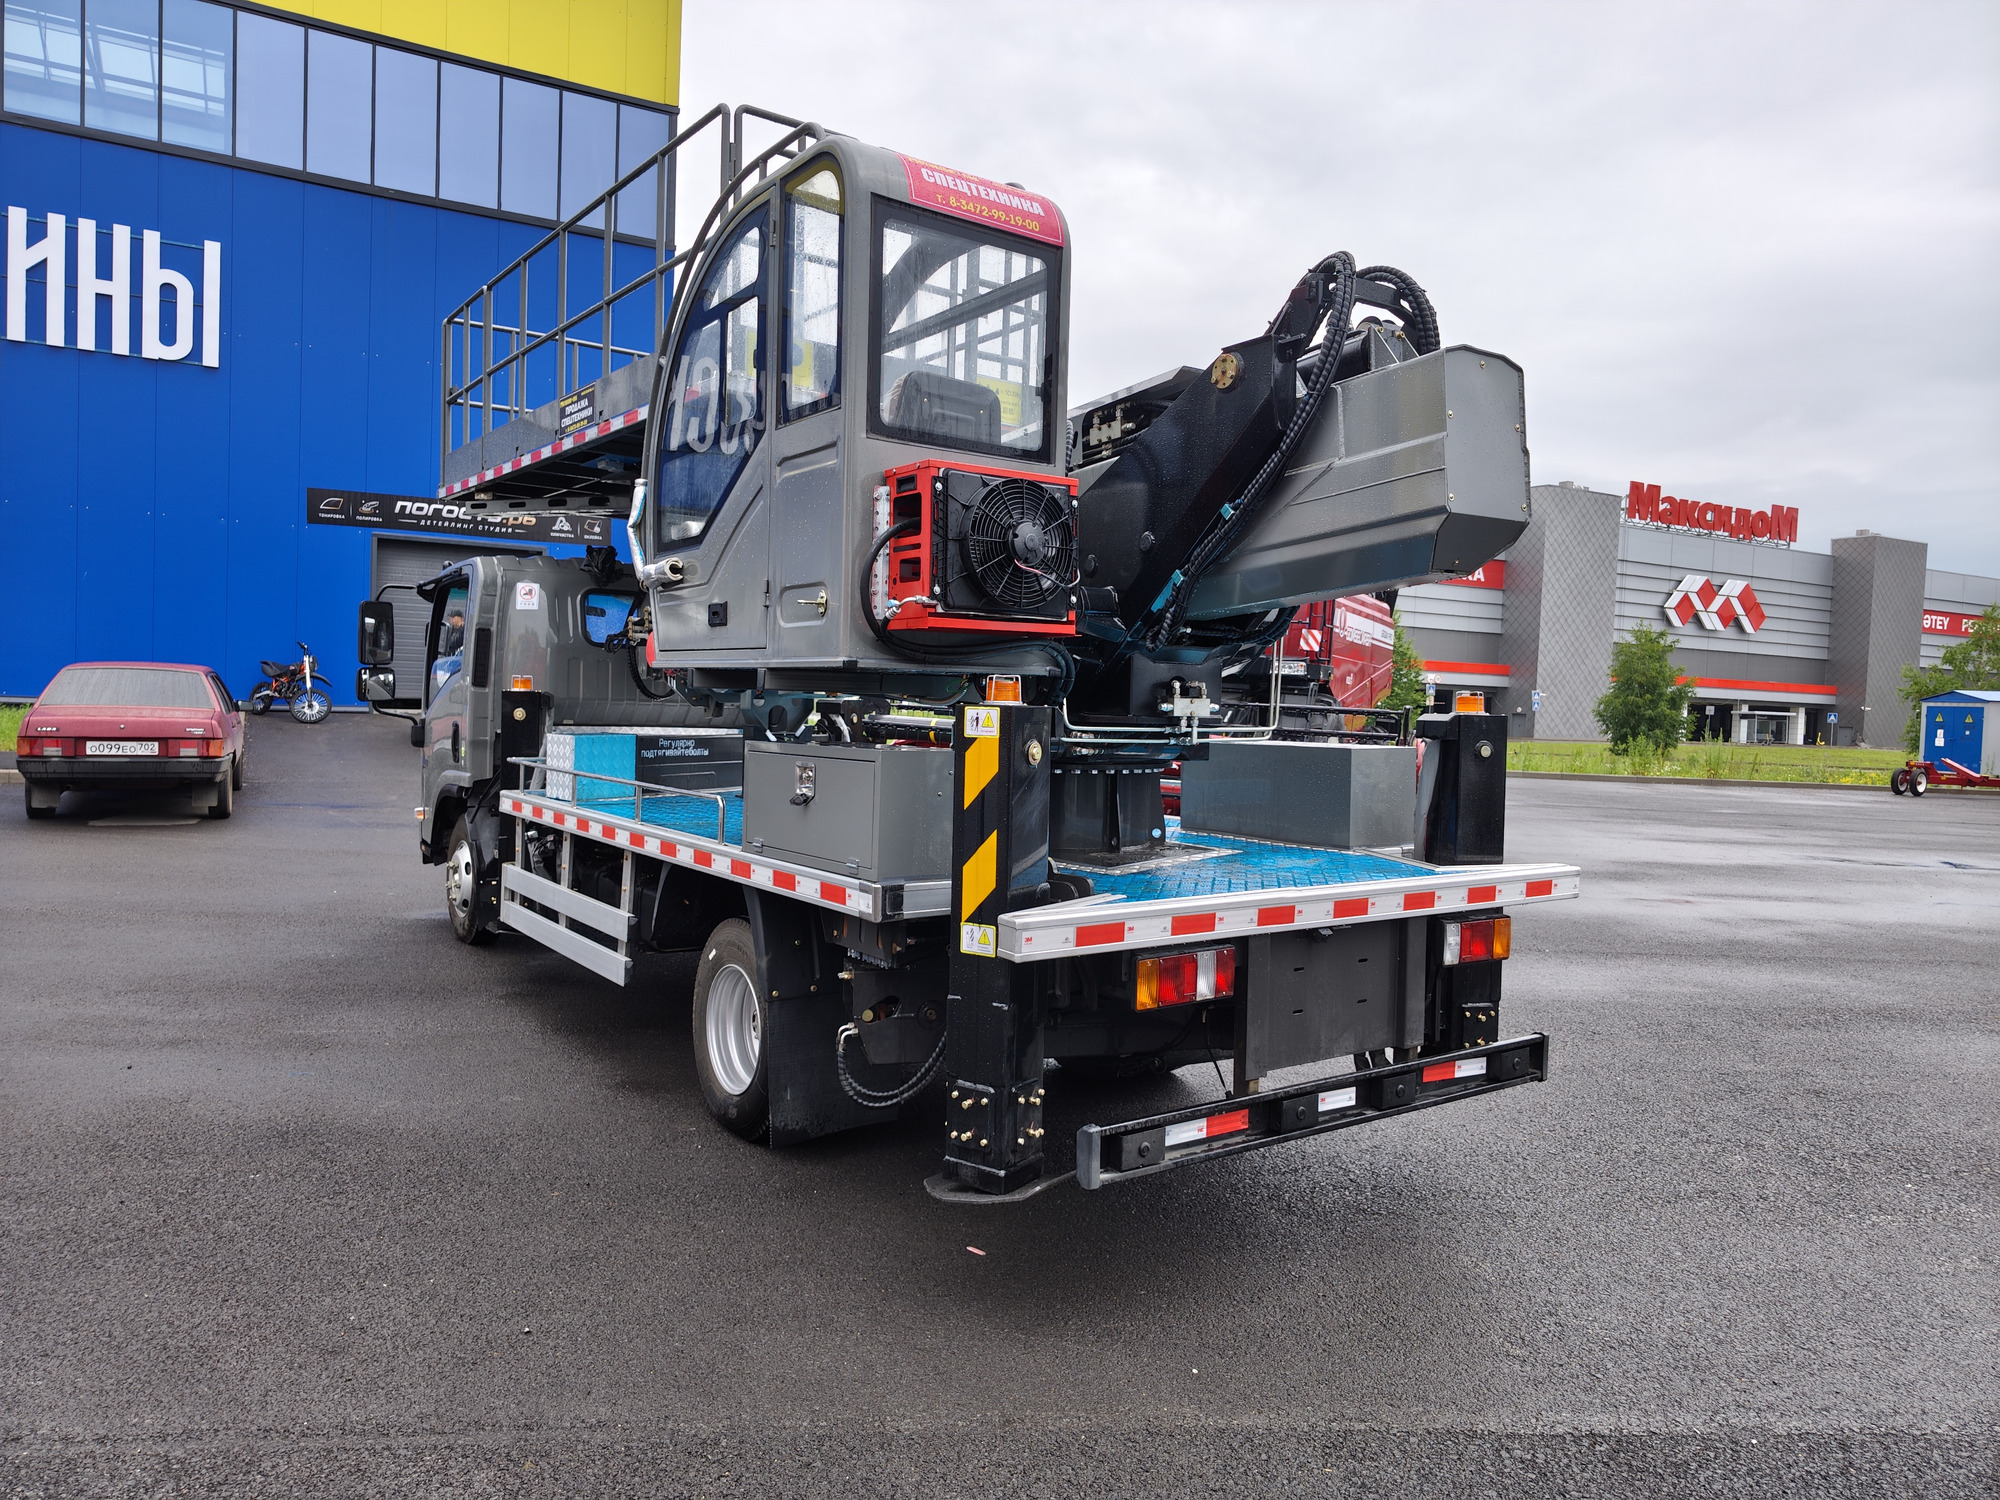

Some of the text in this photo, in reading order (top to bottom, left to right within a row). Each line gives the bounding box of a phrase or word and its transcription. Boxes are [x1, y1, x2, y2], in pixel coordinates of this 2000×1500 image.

[920, 168, 1045, 216] СПЕЦТЕХНИКА
[949, 195, 1040, 232] 8-3472-99-19-00
[7, 205, 221, 368] ИНЫ
[420, 519, 513, 533] ДЕТЕЙЛИНГ СТУДИЯ
[138, 743, 156, 751] 702
[659, 738, 695, 749] Регулярно
